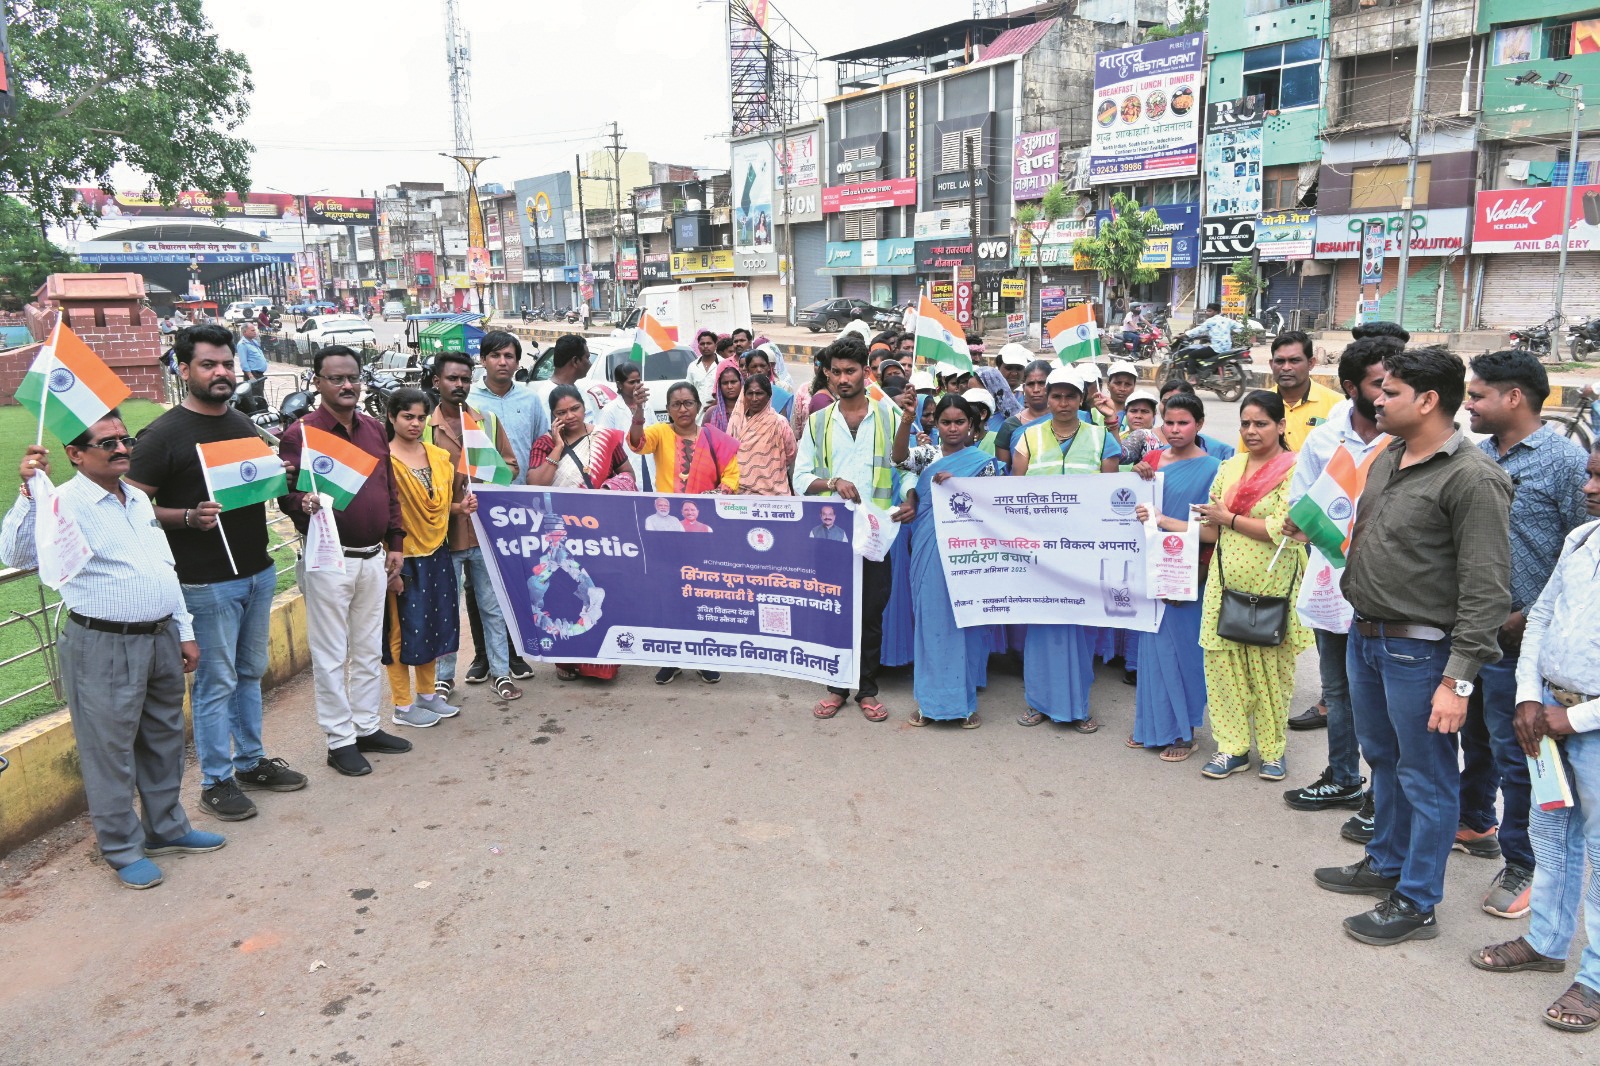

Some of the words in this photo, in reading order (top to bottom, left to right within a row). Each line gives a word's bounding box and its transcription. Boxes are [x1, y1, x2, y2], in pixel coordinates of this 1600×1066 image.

[1132, 52, 1196, 73] RESTAURANT
[1098, 84, 1134, 98] BREAKFAST
[1141, 80, 1162, 90] LUNCH
[1169, 73, 1195, 86] DINNER
[1096, 132, 1112, 144] शुद्ध
[1115, 124, 1150, 139] शाकाहारी
[1152, 120, 1193, 134] भोजनालय
[1021, 132, 1057, 156] सुभाष
[837, 162, 852, 174] OYO
[1096, 164, 1118, 174] 92434
[1120, 162, 1142, 172] 39986
[938, 182, 957, 191] HOTEL
[959, 179, 984, 188] LAVSA
[1014, 176, 1039, 192] नगमा
[326, 199, 343, 212] शिव
[779, 194, 816, 216] AVON
[1486, 197, 1544, 224] Vadilal
[355, 212, 370, 220] कथा
[207, 242, 219, 253] सेतु
[977, 241, 1008, 259] OYO
[1316, 241, 1355, 252] NISHANT
[1410, 237, 1462, 249] SOLUTION
[1514, 241, 1541, 250] ANIL
[1545, 239, 1590, 249] BAERY
[216, 253, 245, 262] प्रवेश
[251, 252, 281, 263] निषेध
[742, 258, 766, 271] oppo
[643, 267, 657, 276] SVS
[700, 303, 717, 311] CMS
[958, 285, 969, 323] OYO
[657, 307, 666, 316] CMS
[994, 496, 1014, 504] नगर
[1016, 492, 1049, 504] पालिक
[1051, 491, 1078, 503] निगम
[770, 510, 796, 519] बनाएं
[1004, 506, 1032, 515] भिलाई,
[1033, 505, 1069, 516] छत्तीसगढ़
[489, 505, 544, 533] Say
[562, 514, 599, 529] no
[520, 534, 640, 558] Plastic
[948, 537, 978, 549] सिंगल
[980, 537, 997, 550] यूज
[999, 537, 1041, 549] प्लास्टिक
[1043, 540, 1058, 550] का
[1060, 538, 1095, 550] विकल्प
[1098, 539, 1140, 553] अपनाएं,
[680, 565, 720, 583] सिंगल
[722, 572, 745, 589] यूज
[745, 572, 802, 592] प्लास्टिक
[802, 577, 842, 597] छोड़ना
[681, 585, 693, 598] ही
[693, 584, 746, 602] समझदारी
[747, 589, 755, 603] है
[756, 592, 808, 608] #स्वच्छता
[808, 597, 833, 612] जारी
[834, 599, 842, 614] है
[696, 605, 713, 614] उचित
[713, 605, 738, 615] विकल्प
[704, 613, 719, 622] लिए
[719, 614, 737, 623] स्कैन
[736, 614, 749, 624] करें
[642, 638, 682, 654] नगर
[684, 637, 737, 659] पालिक
[739, 640, 788, 664] निगम
[790, 646, 841, 676] भिलाई
